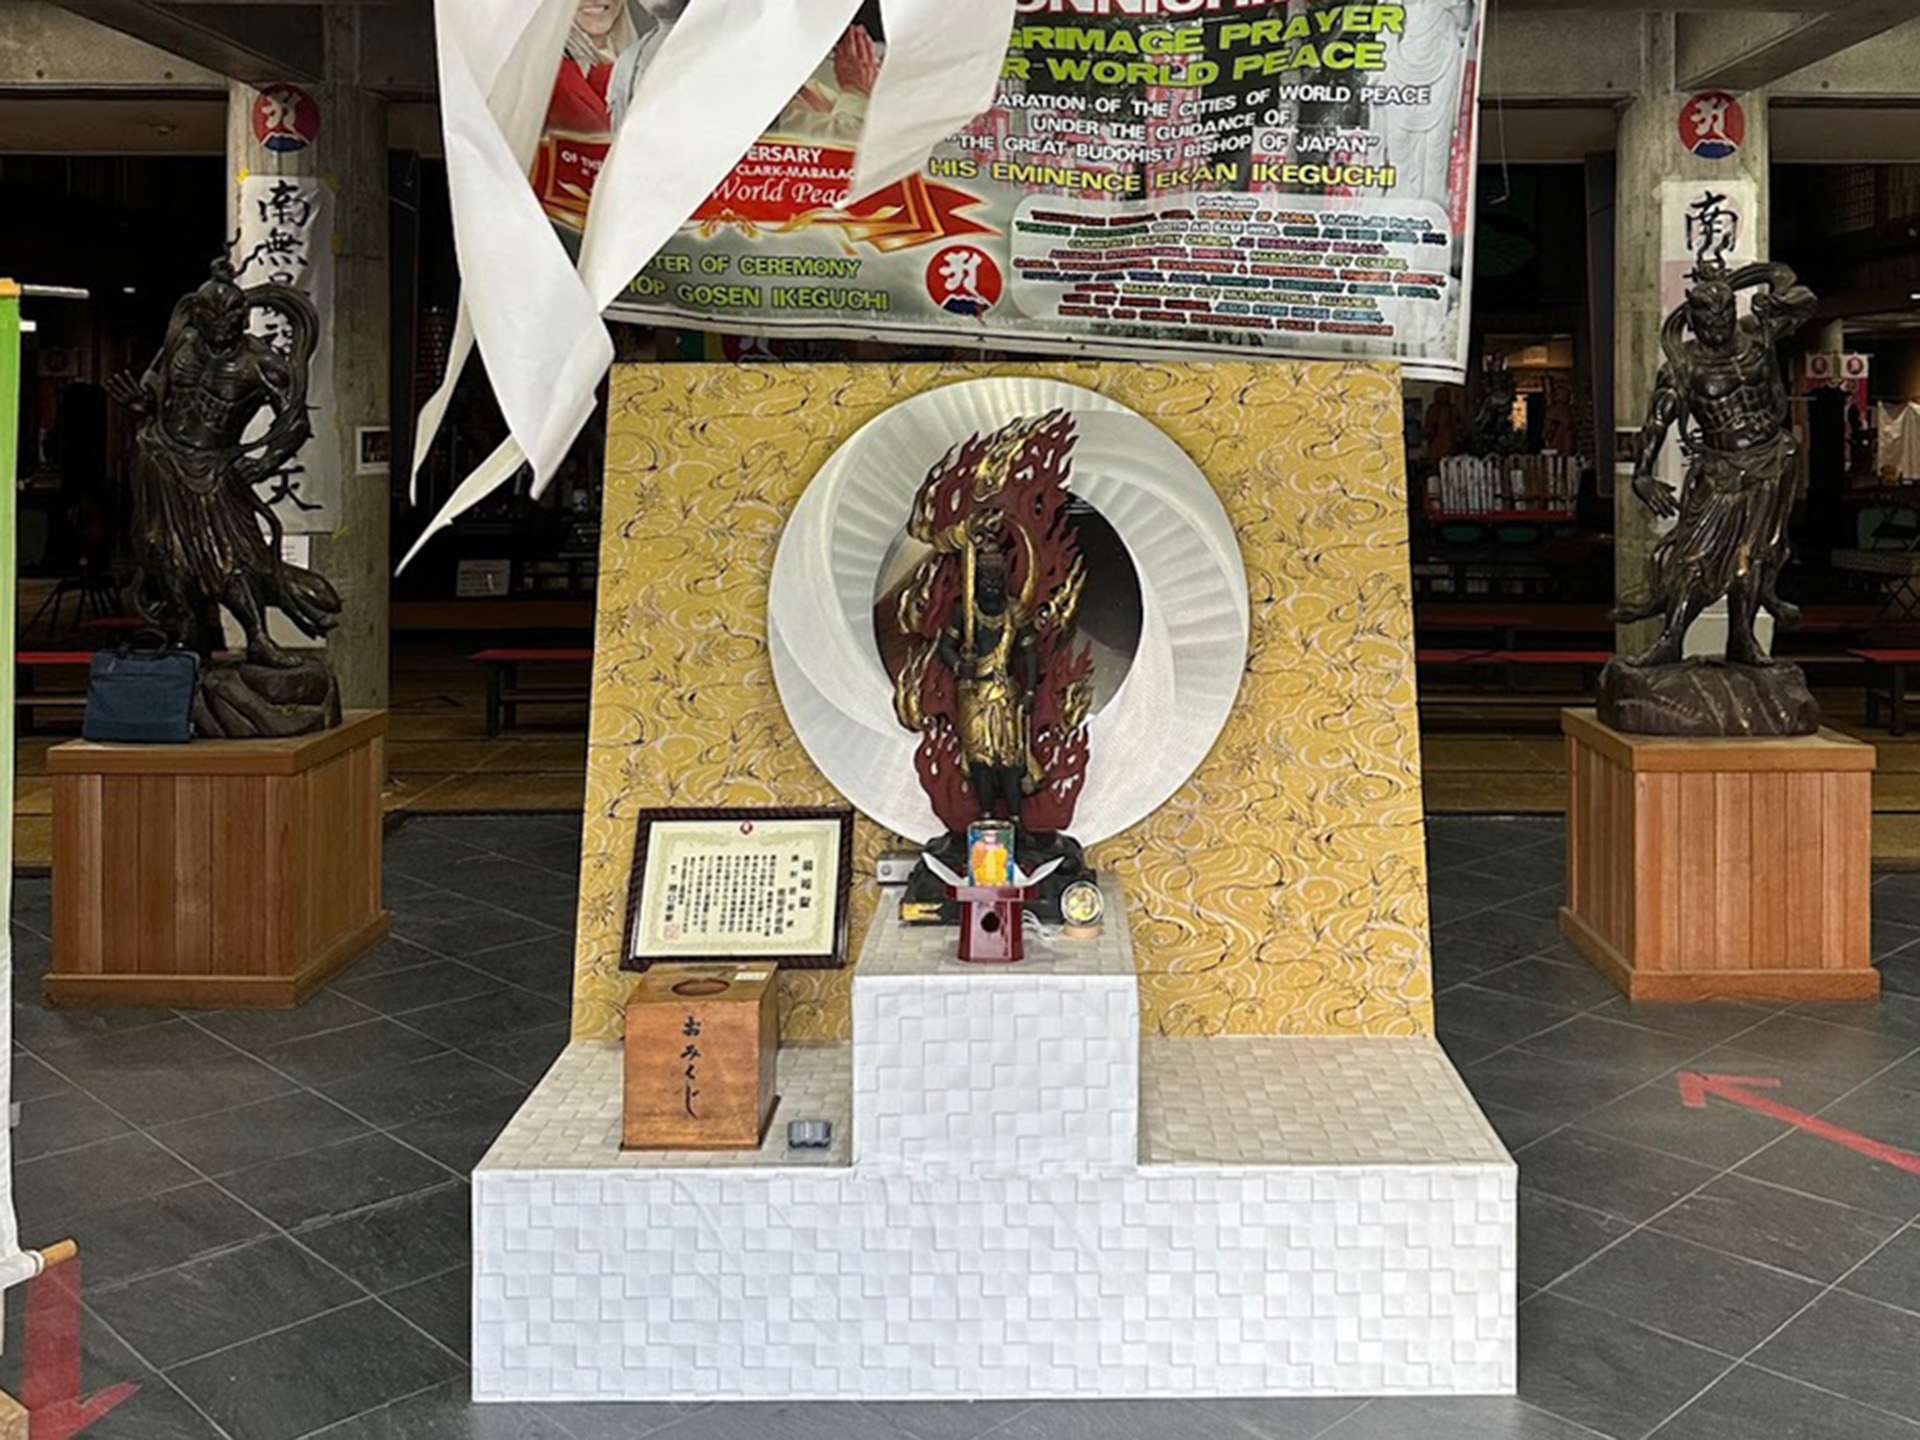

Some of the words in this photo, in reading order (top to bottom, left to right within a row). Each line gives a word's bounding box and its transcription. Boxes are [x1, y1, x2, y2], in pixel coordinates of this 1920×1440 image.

[1219, 5, 1405, 49] PRAYER
[1046, 58, 1219, 86] WORLD
[1232, 41, 1386, 80] PEACE
[997, 93, 1086, 112] ARATION
[1095, 97, 1122, 113] OF
[1131, 100, 1168, 118] THE
[1179, 95, 1237, 116] CITIES
[1246, 88, 1271, 106] OF
[1278, 85, 1351, 103] WORLD
[1361, 87, 1430, 104] PEACE
[1033, 117, 1099, 135] UNDER
[1110, 122, 1146, 140] THE
[1156, 112, 1256, 141] GUIDANCE
[1264, 110, 1291, 126] OF
[1005, 137, 1067, 155] GREAT
[1076, 144, 1174, 162] BUDDHIST
[1184, 135, 1252, 158] BISHOP
[1262, 134, 1287, 150] OF
[712, 176, 790, 202] World
[929, 160, 978, 177] HIS
[993, 164, 1141, 192] EMINENCE
[1155, 163, 1237, 188] EKAN
[1252, 163, 1395, 186] IKEGUCHI
[648, 255, 690, 273] TER
[701, 255, 730, 273] OF
[740, 257, 861, 279] CEREMONY
[677, 284, 761, 307] GOSEN
[773, 288, 888, 310] IKEGUCHI
[680, 1015, 702, 1120] おみくじ
